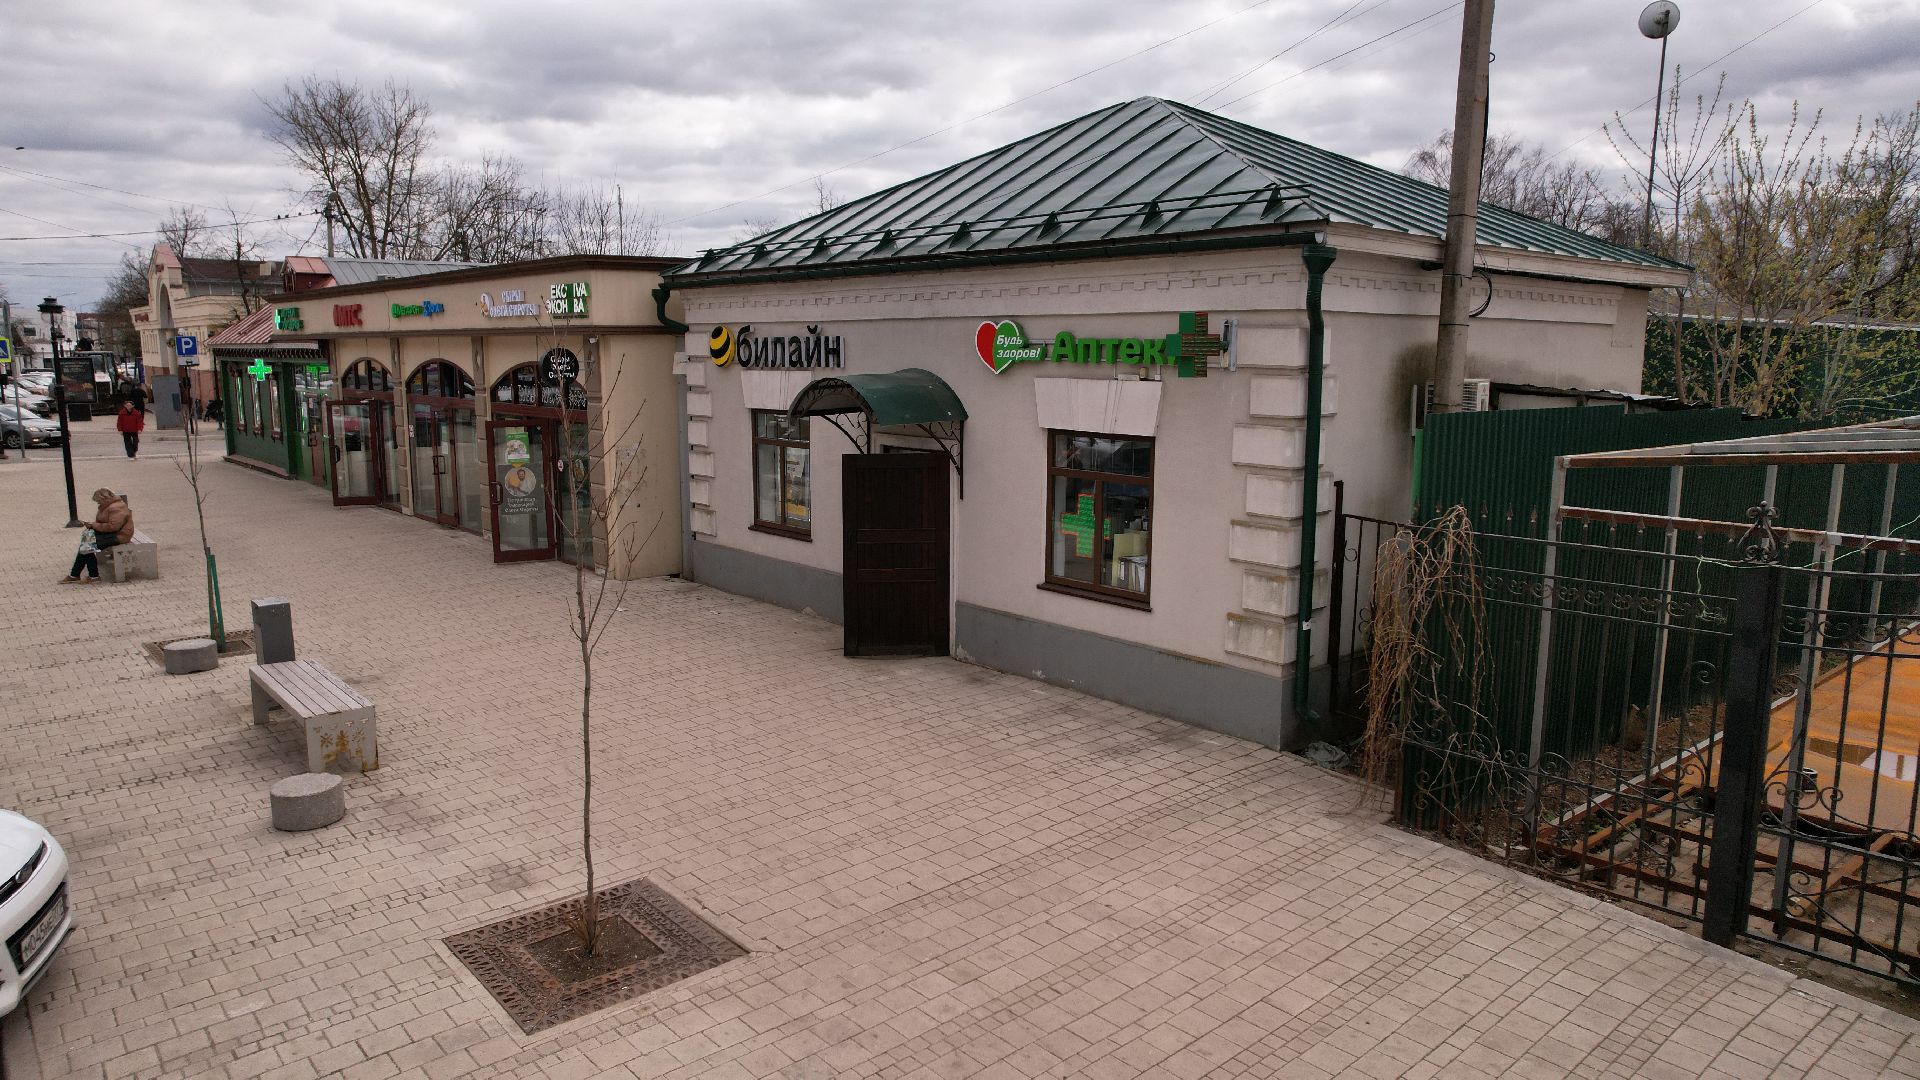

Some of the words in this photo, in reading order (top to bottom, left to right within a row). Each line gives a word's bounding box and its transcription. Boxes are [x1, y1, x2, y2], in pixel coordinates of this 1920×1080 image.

[550, 282, 588, 299] EKOIVA
[545, 297, 585, 314] ЭКОНВА
[736, 324, 844, 368] билайн
[996, 334, 1023, 346] Будь
[1051, 331, 1178, 366] Аптек
[996, 347, 1041, 360] здоров!
